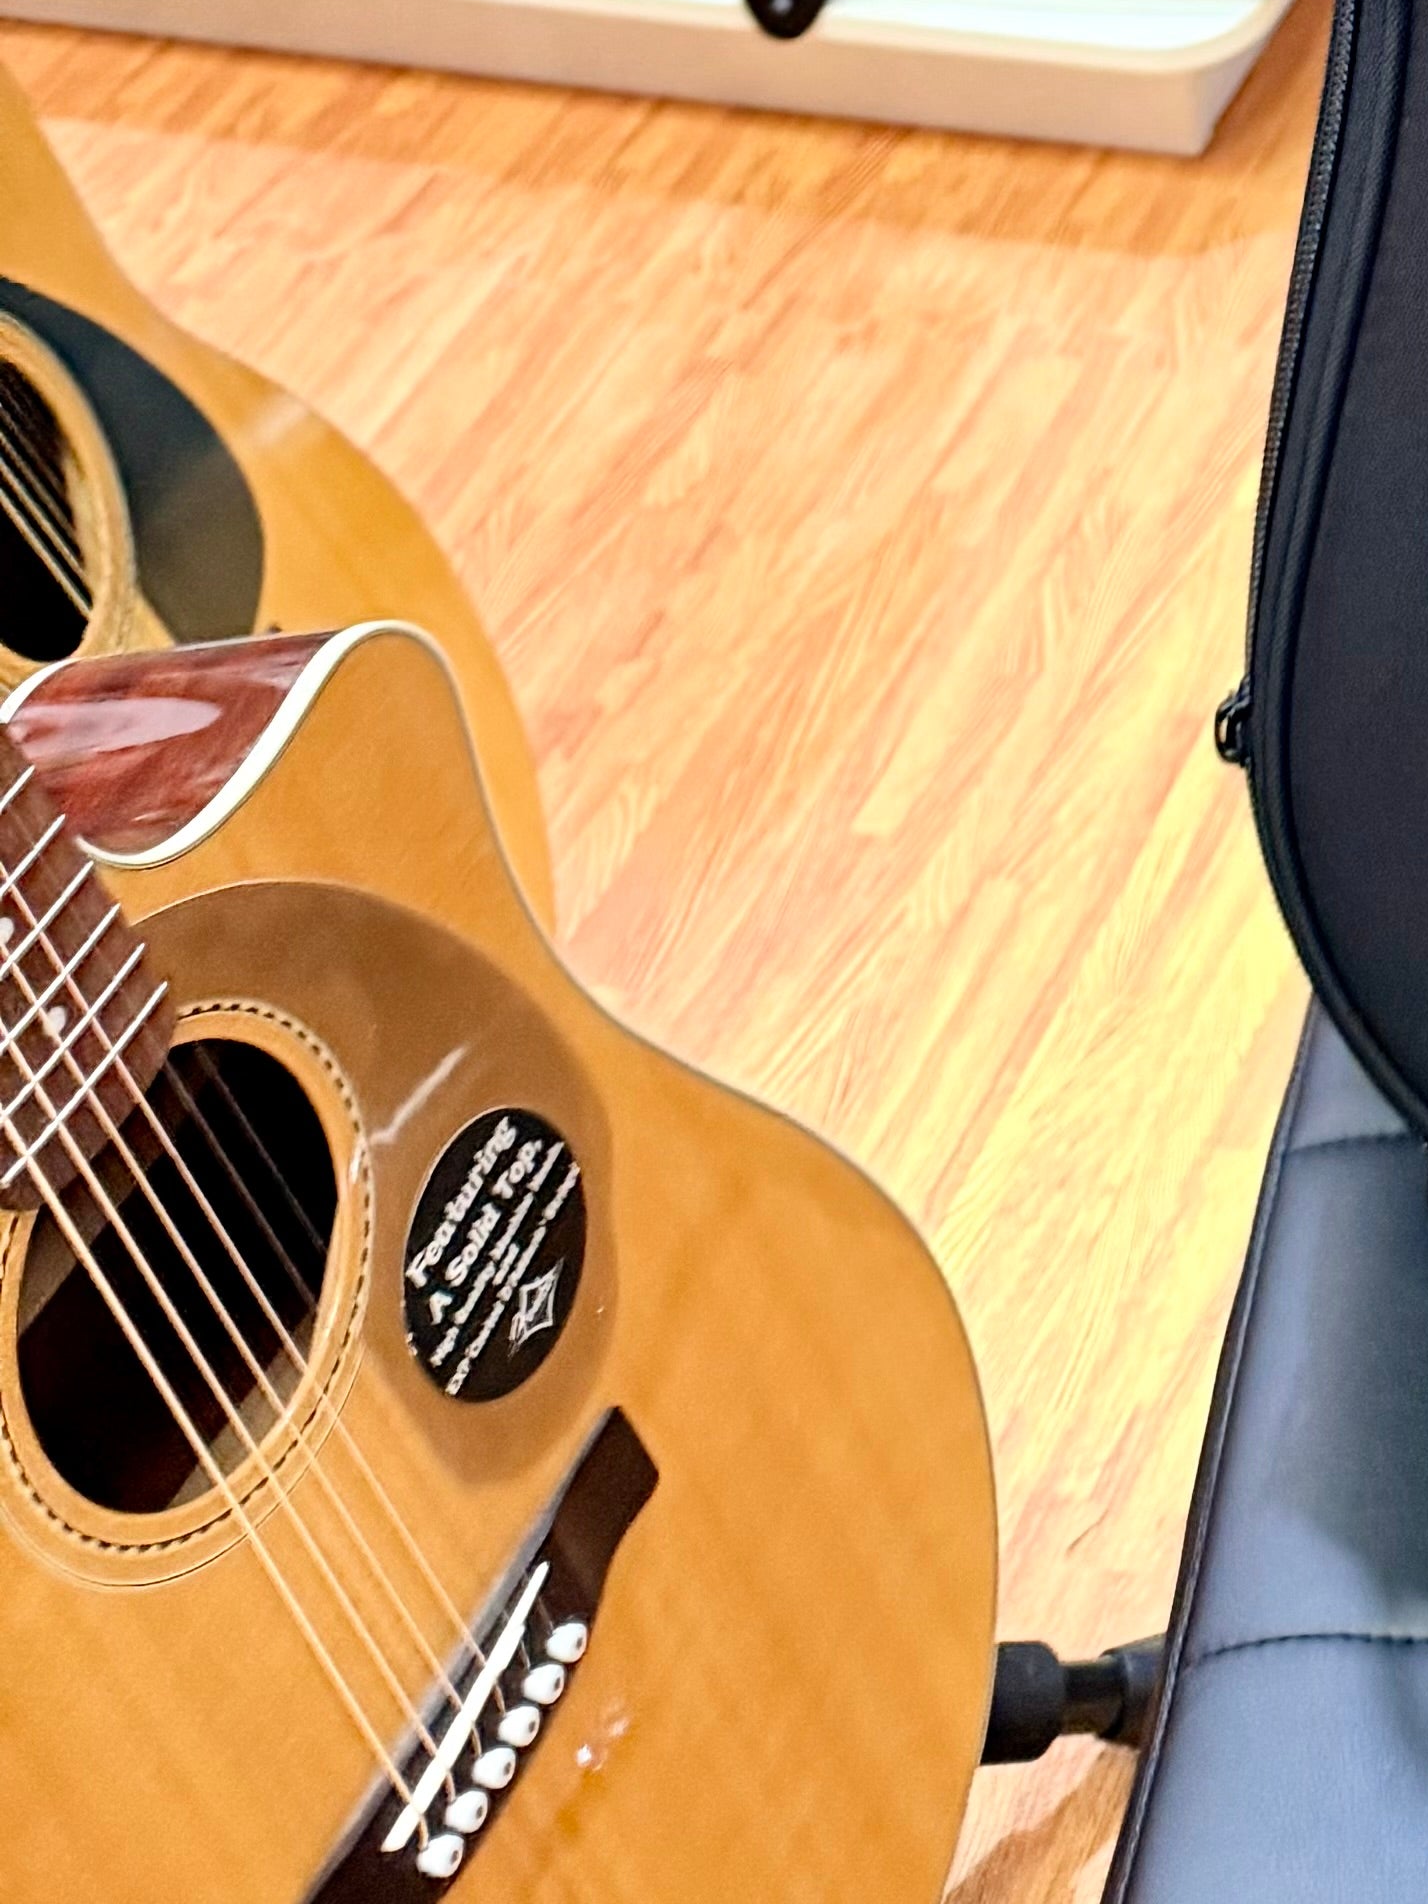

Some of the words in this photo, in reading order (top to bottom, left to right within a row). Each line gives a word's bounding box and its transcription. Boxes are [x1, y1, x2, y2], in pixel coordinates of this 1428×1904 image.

[405, 1116, 517, 1288] Featuring
[429, 1291, 454, 1325] A
[446, 1202, 501, 1287] Solid
